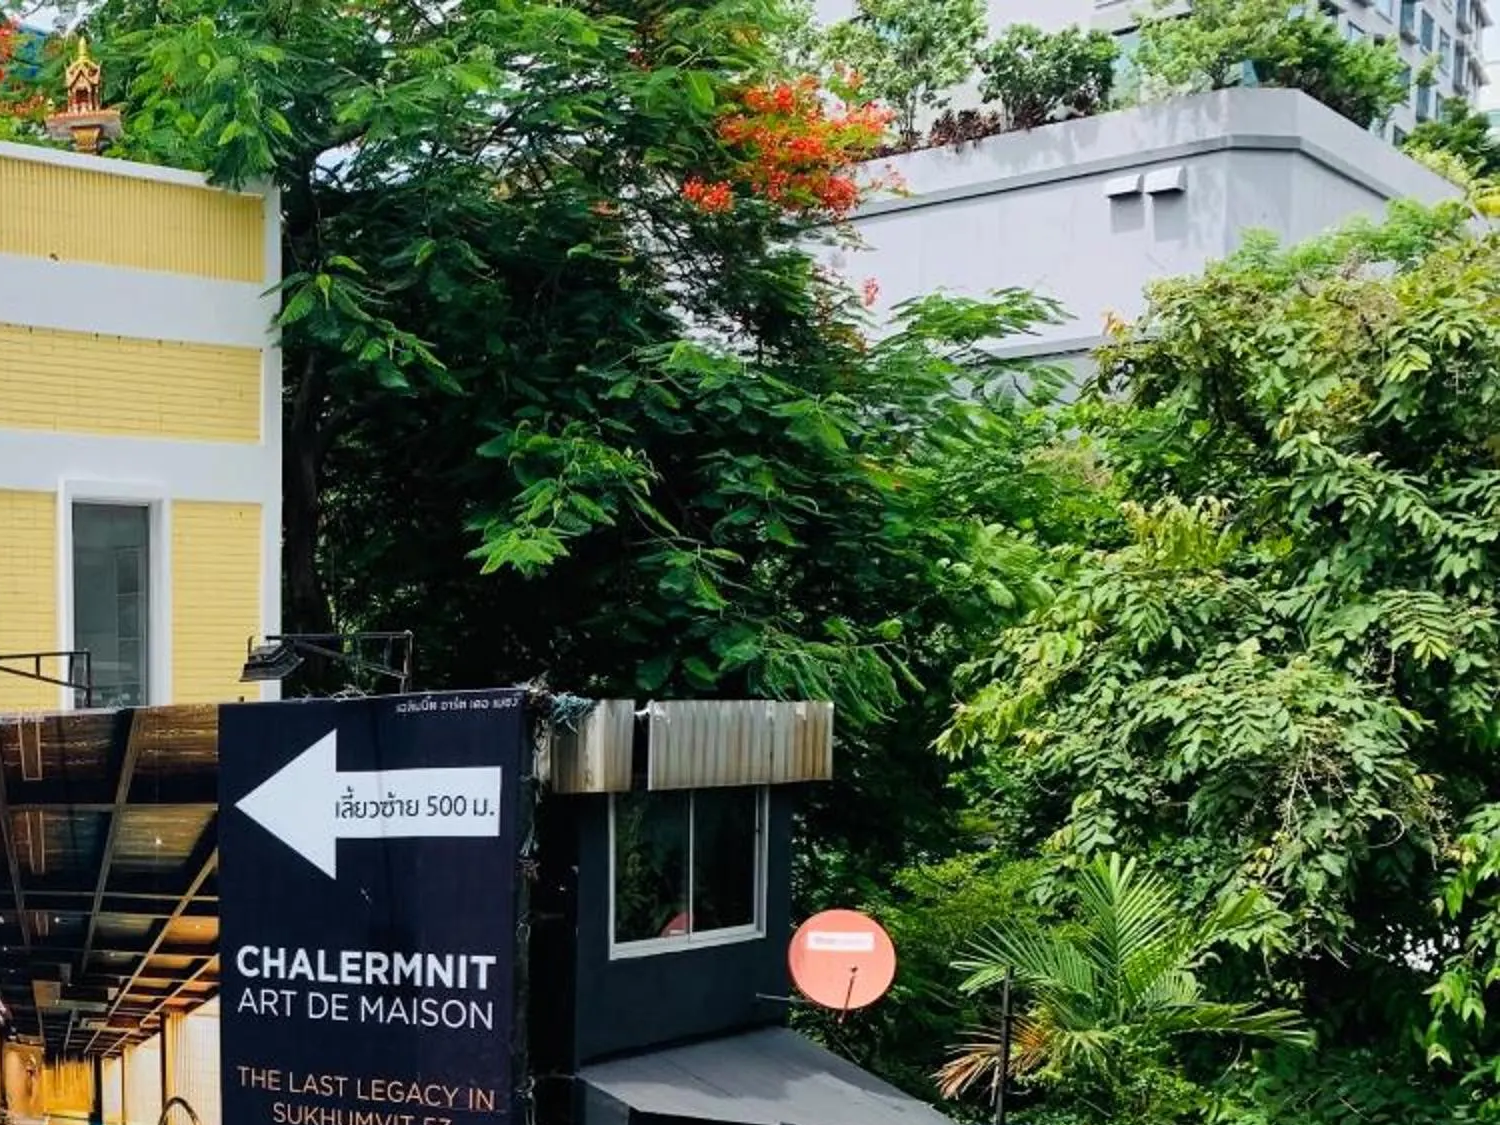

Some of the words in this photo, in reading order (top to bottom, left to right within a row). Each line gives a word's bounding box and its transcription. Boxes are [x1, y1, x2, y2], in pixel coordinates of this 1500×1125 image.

[335, 786, 419, 818] เลี้ยวซ้าย
[426, 795, 467, 817] 500
[236, 945, 497, 990] CHALERMNIT
[237, 988, 297, 1017] ART
[308, 992, 349, 1021] DE
[360, 996, 494, 1030] MAISON
[237, 1066, 281, 1091] THE
[289, 1072, 348, 1097] LAST
[357, 1079, 459, 1107] LEGACY
[468, 1088, 495, 1111] IN
